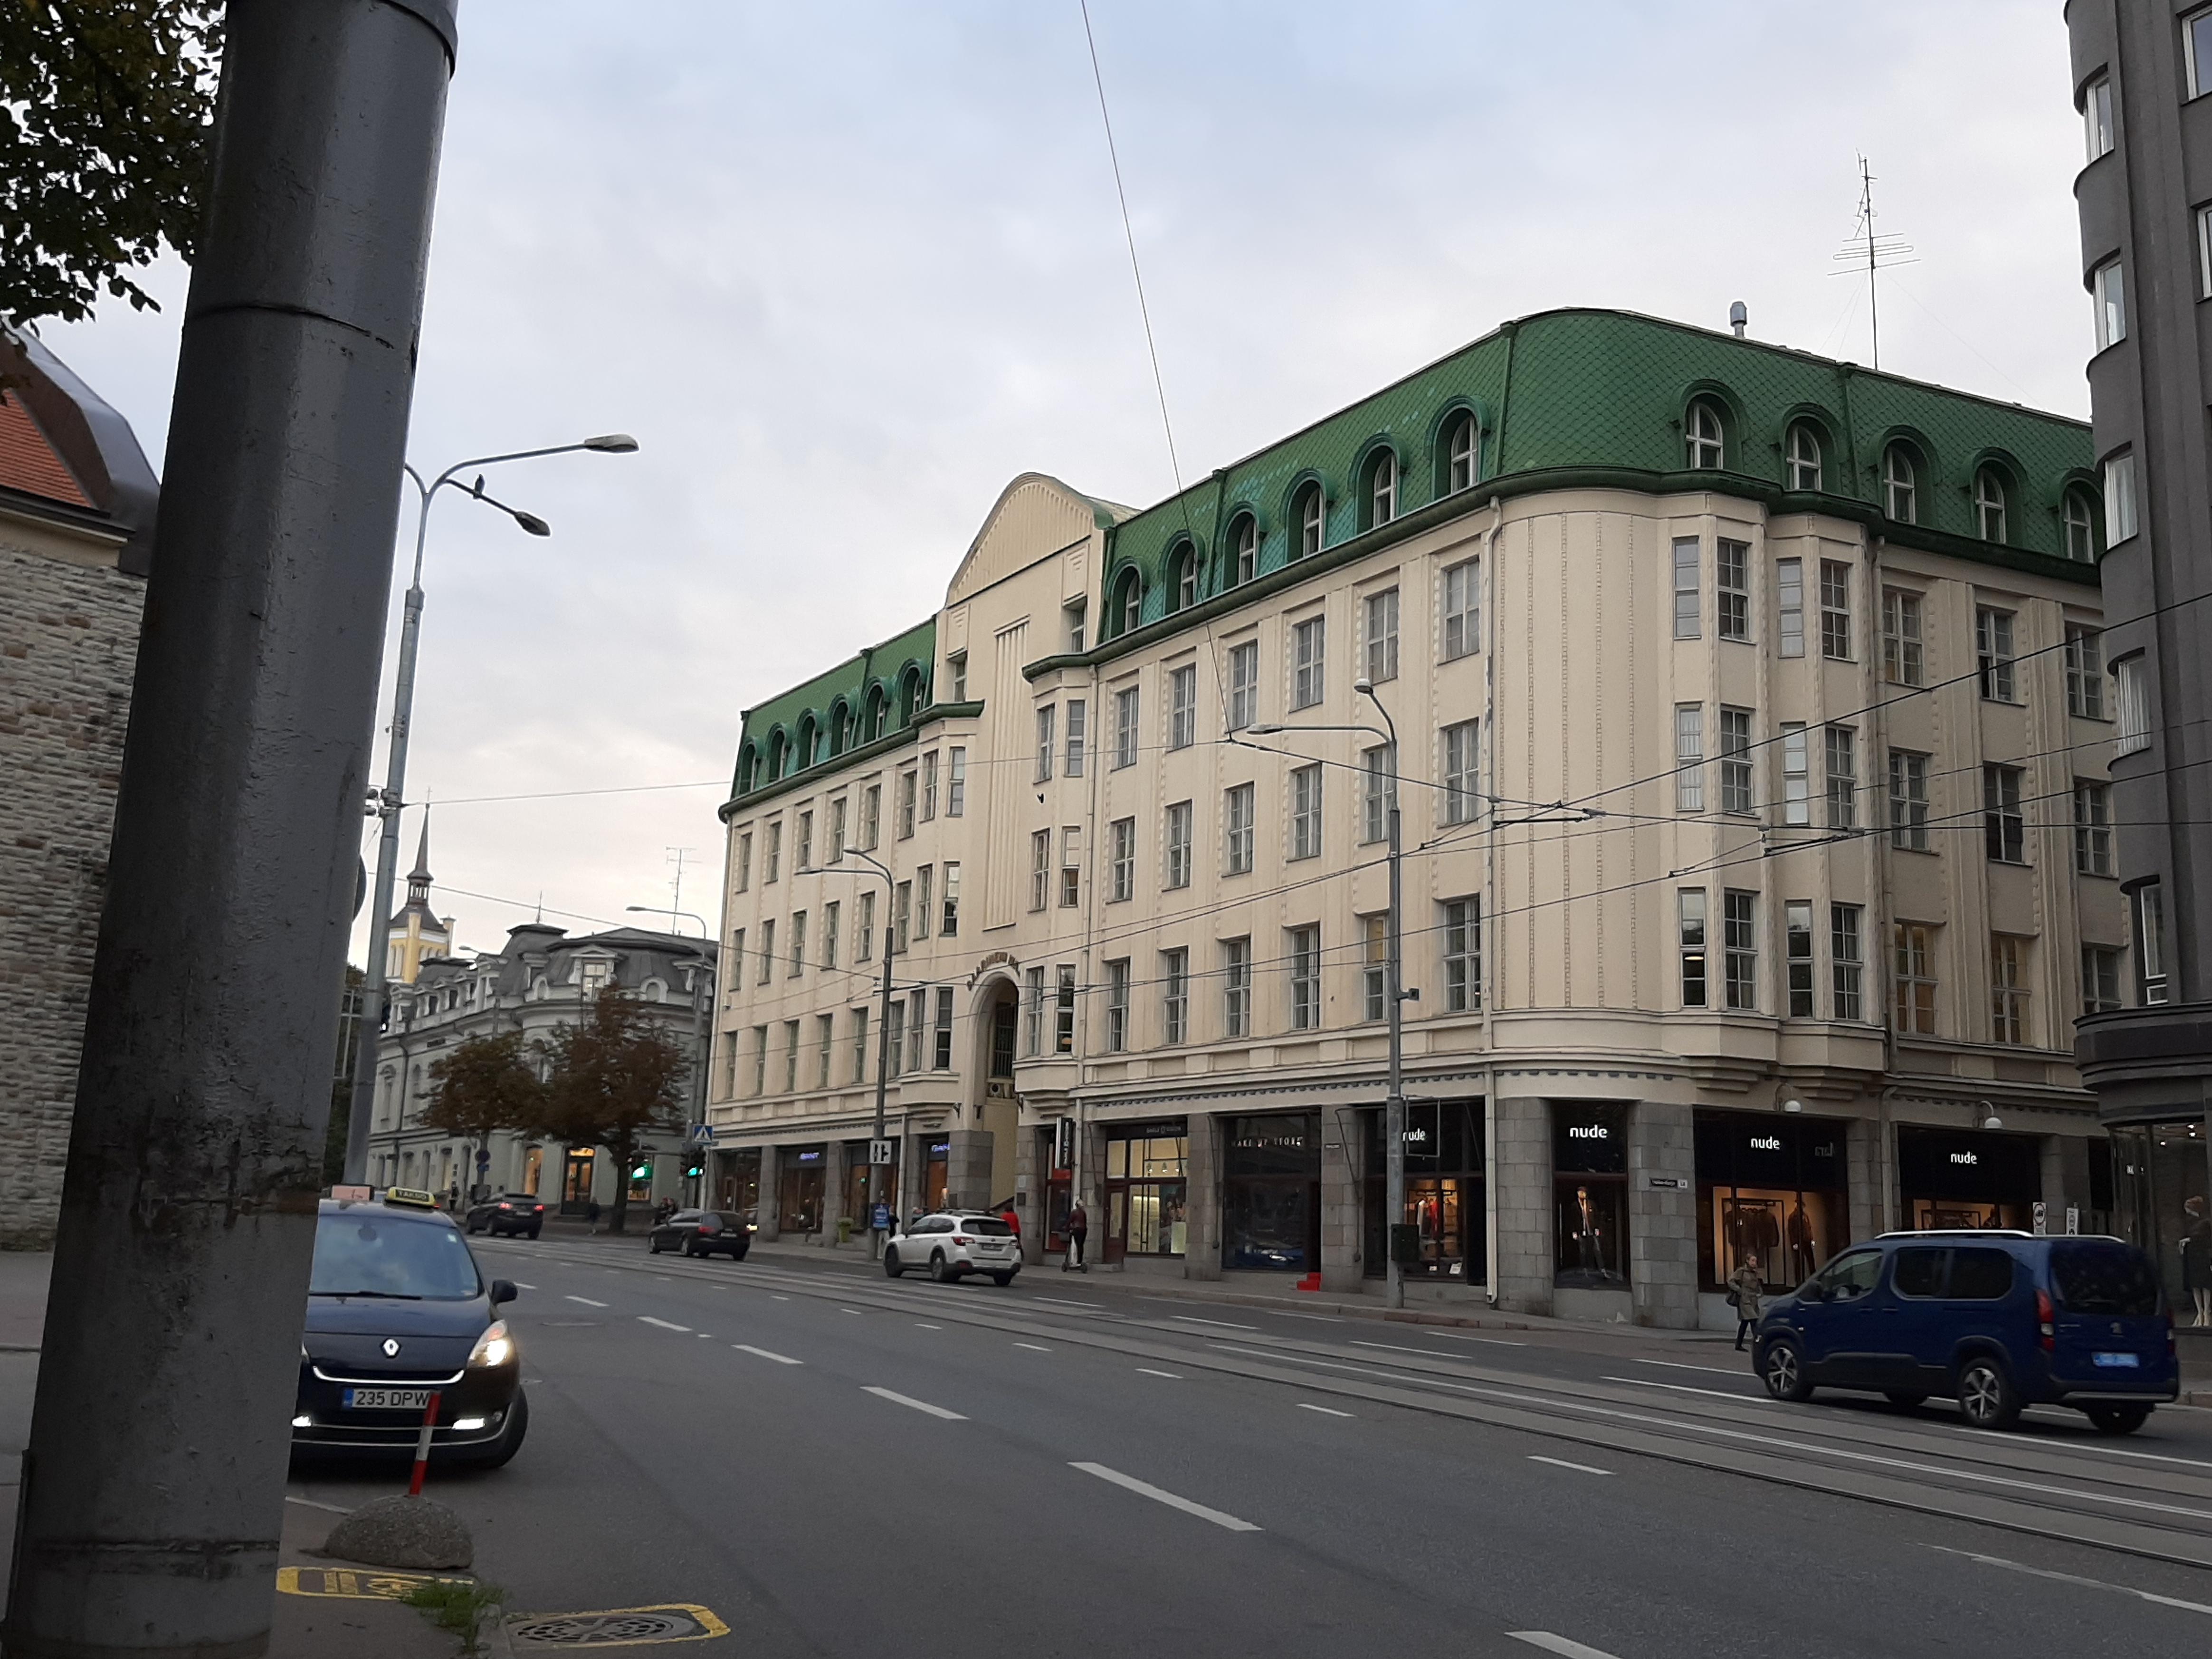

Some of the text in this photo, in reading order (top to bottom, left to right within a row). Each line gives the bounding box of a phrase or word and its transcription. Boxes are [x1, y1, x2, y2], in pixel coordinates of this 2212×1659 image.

[1402, 1127, 1426, 1142] nude
[1570, 1124, 1608, 1138] nude
[1751, 1135, 1780, 1150] nude
[1950, 1151, 1978, 1164] nude
[356, 1391, 429, 1406] 235 DPW
